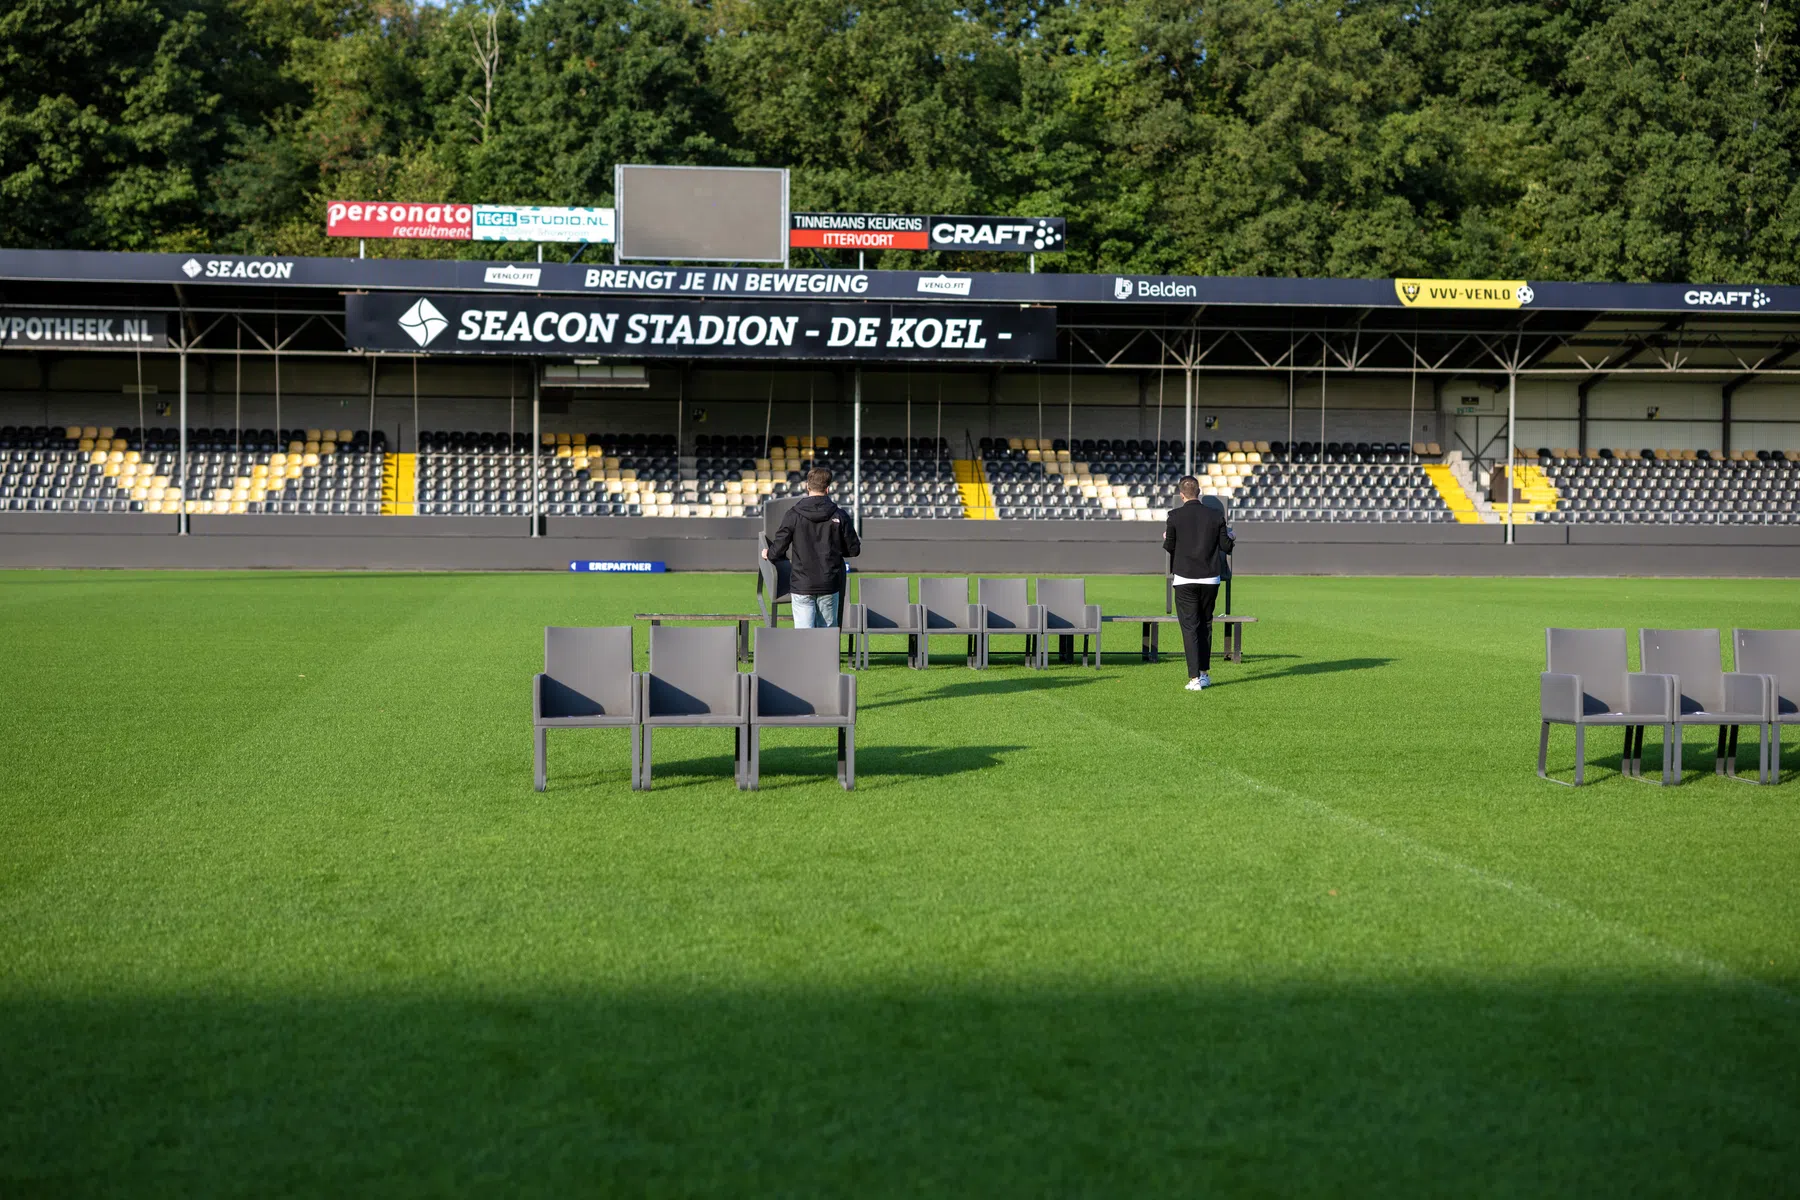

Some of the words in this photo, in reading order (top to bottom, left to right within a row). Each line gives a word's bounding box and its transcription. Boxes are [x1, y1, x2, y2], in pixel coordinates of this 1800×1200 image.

[328, 203, 471, 227] personato
[478, 212, 516, 225] TEGEL
[520, 215, 609, 226] STUDIO.NL
[794, 215, 865, 229] TINNEMANS
[867, 217, 923, 231] KEUKENS
[393, 225, 470, 239] recruitment
[822, 232, 895, 247] ITTERVOORT
[931, 222, 1034, 246] CRAFT
[205, 260, 294, 279] SEACON
[584, 269, 677, 290] BRENGT
[679, 271, 705, 291] JE
[712, 272, 739, 292] IN
[745, 272, 869, 294] BEWEGING
[1138, 280, 1197, 298] Belden
[1430, 287, 1511, 301] VVV-VENLO
[1684, 289, 1752, 306] CRAFT
[457, 309, 619, 343] SEACON
[624, 313, 799, 347] STADION
[827, 317, 881, 348] DE
[886, 317, 987, 350] KOEL
[588, 561, 652, 572] EREPARTNER
